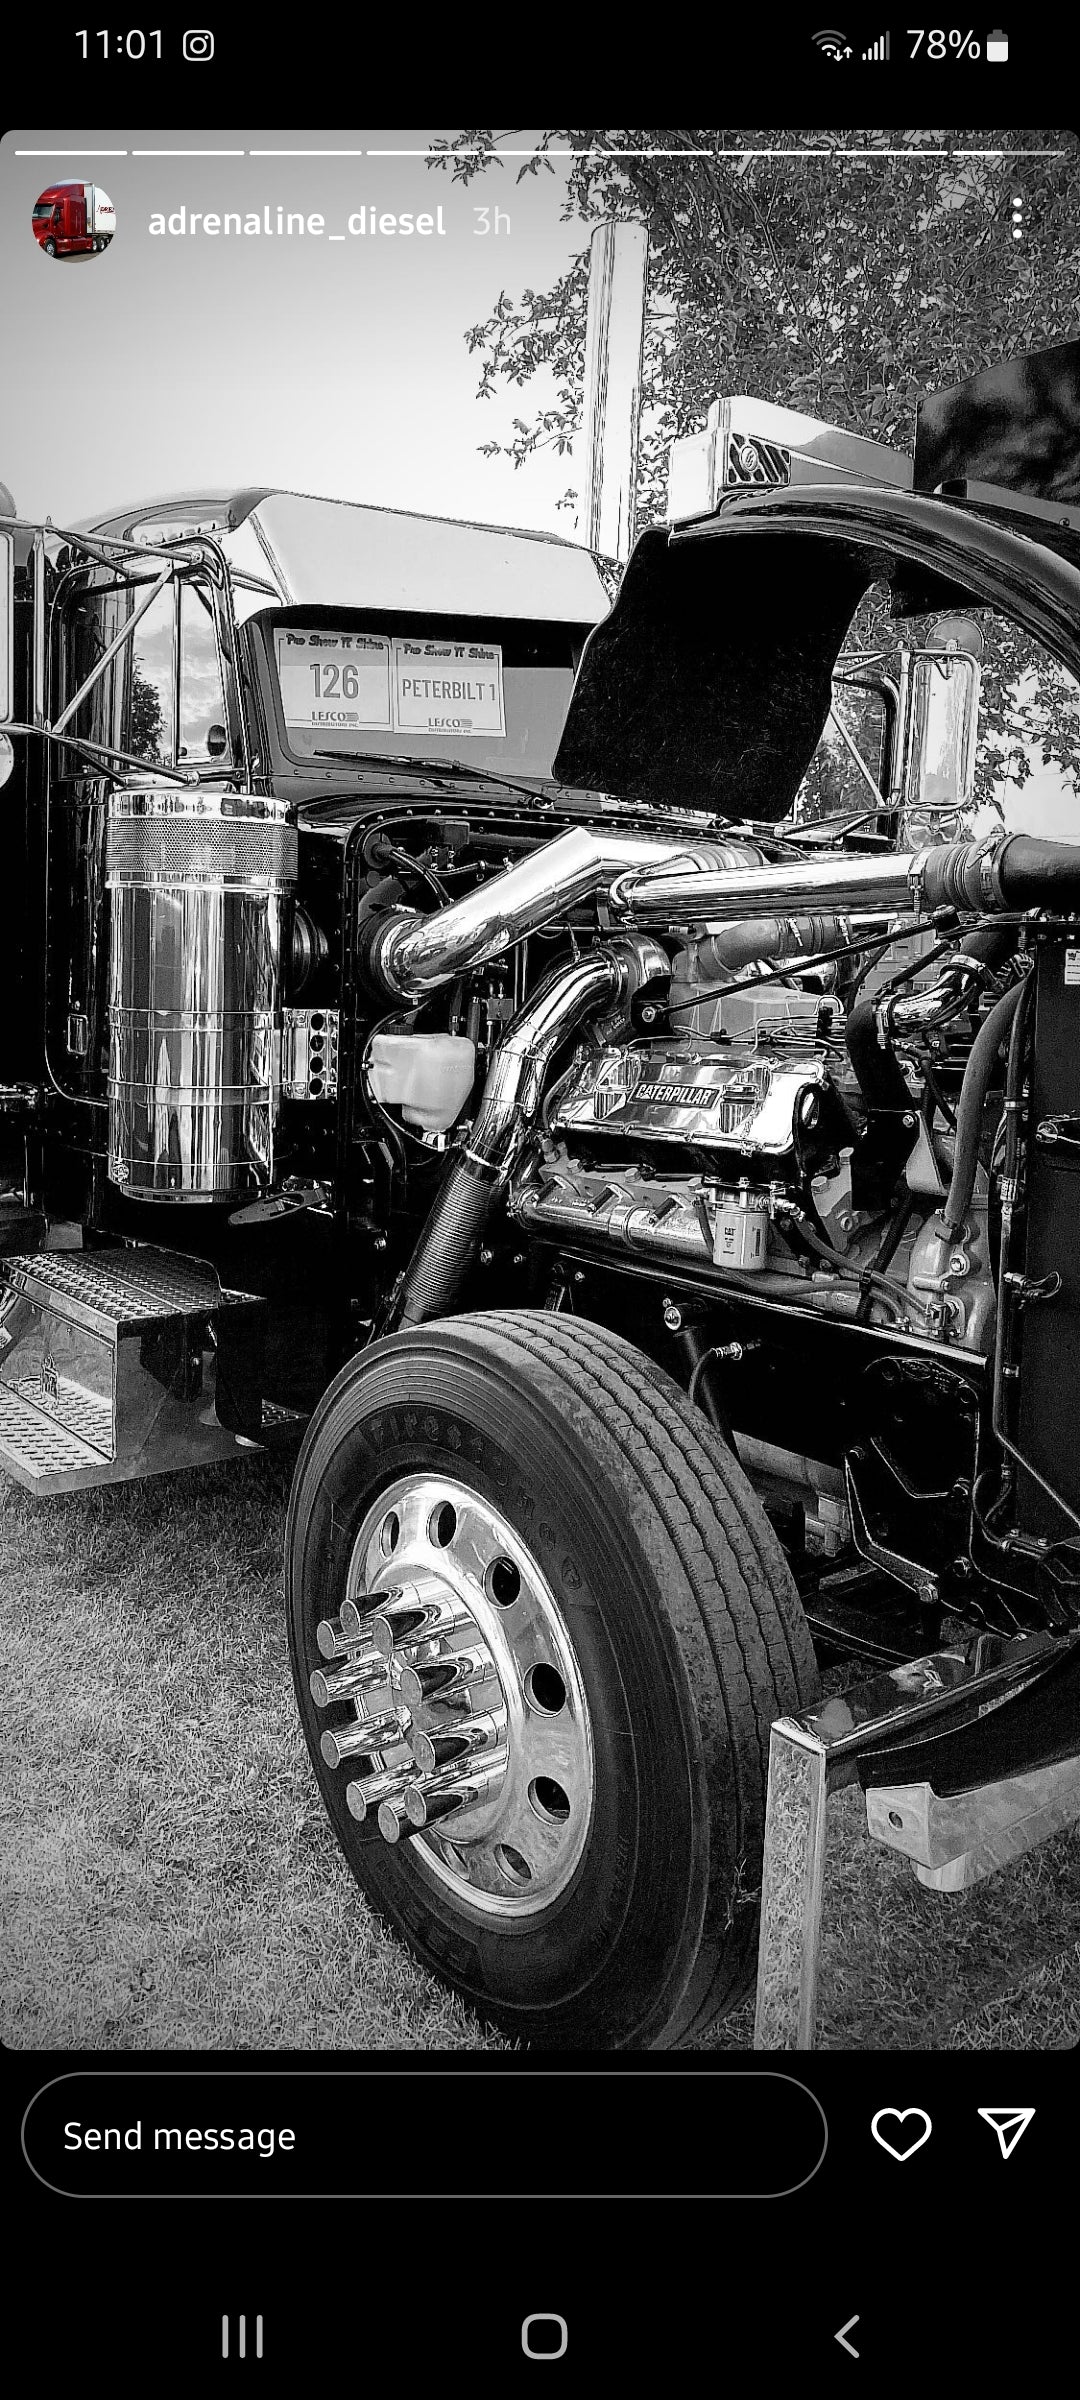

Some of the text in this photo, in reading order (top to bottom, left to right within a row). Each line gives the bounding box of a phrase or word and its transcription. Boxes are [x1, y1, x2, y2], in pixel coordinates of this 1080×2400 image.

[310, 663, 359, 699] 126
[402, 678, 496, 701] PETERBILT 1
[311, 711, 346, 722] LESCO
[428, 717, 460, 728] LESCO
[635, 1083, 712, 1105] CATERPILLAR
